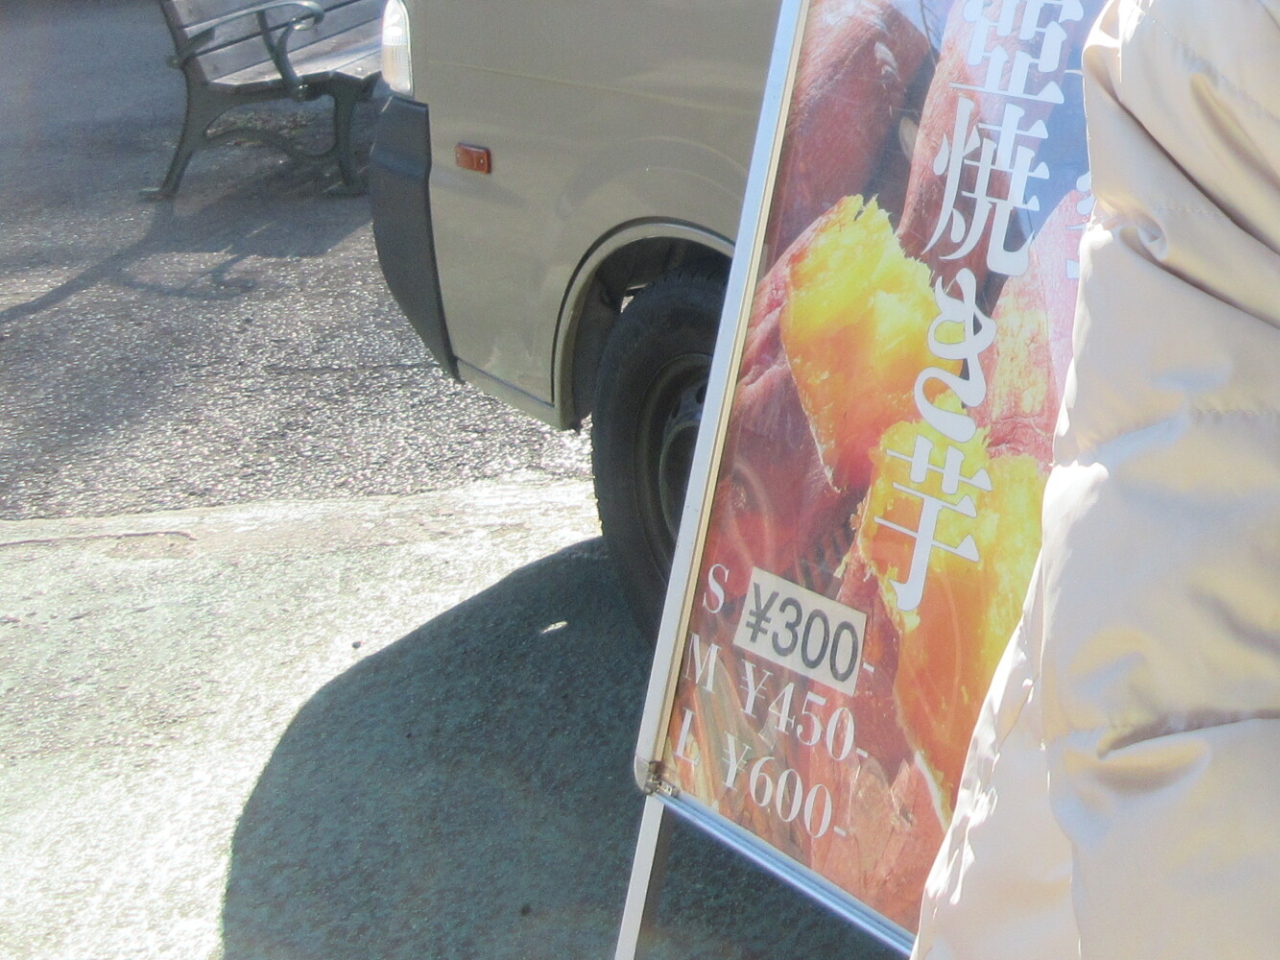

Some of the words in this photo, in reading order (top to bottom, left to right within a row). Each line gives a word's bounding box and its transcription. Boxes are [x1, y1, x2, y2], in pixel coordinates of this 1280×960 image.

[702, 563, 730, 614] S
[682, 632, 722, 695] M
[674, 708, 700, 766] L
